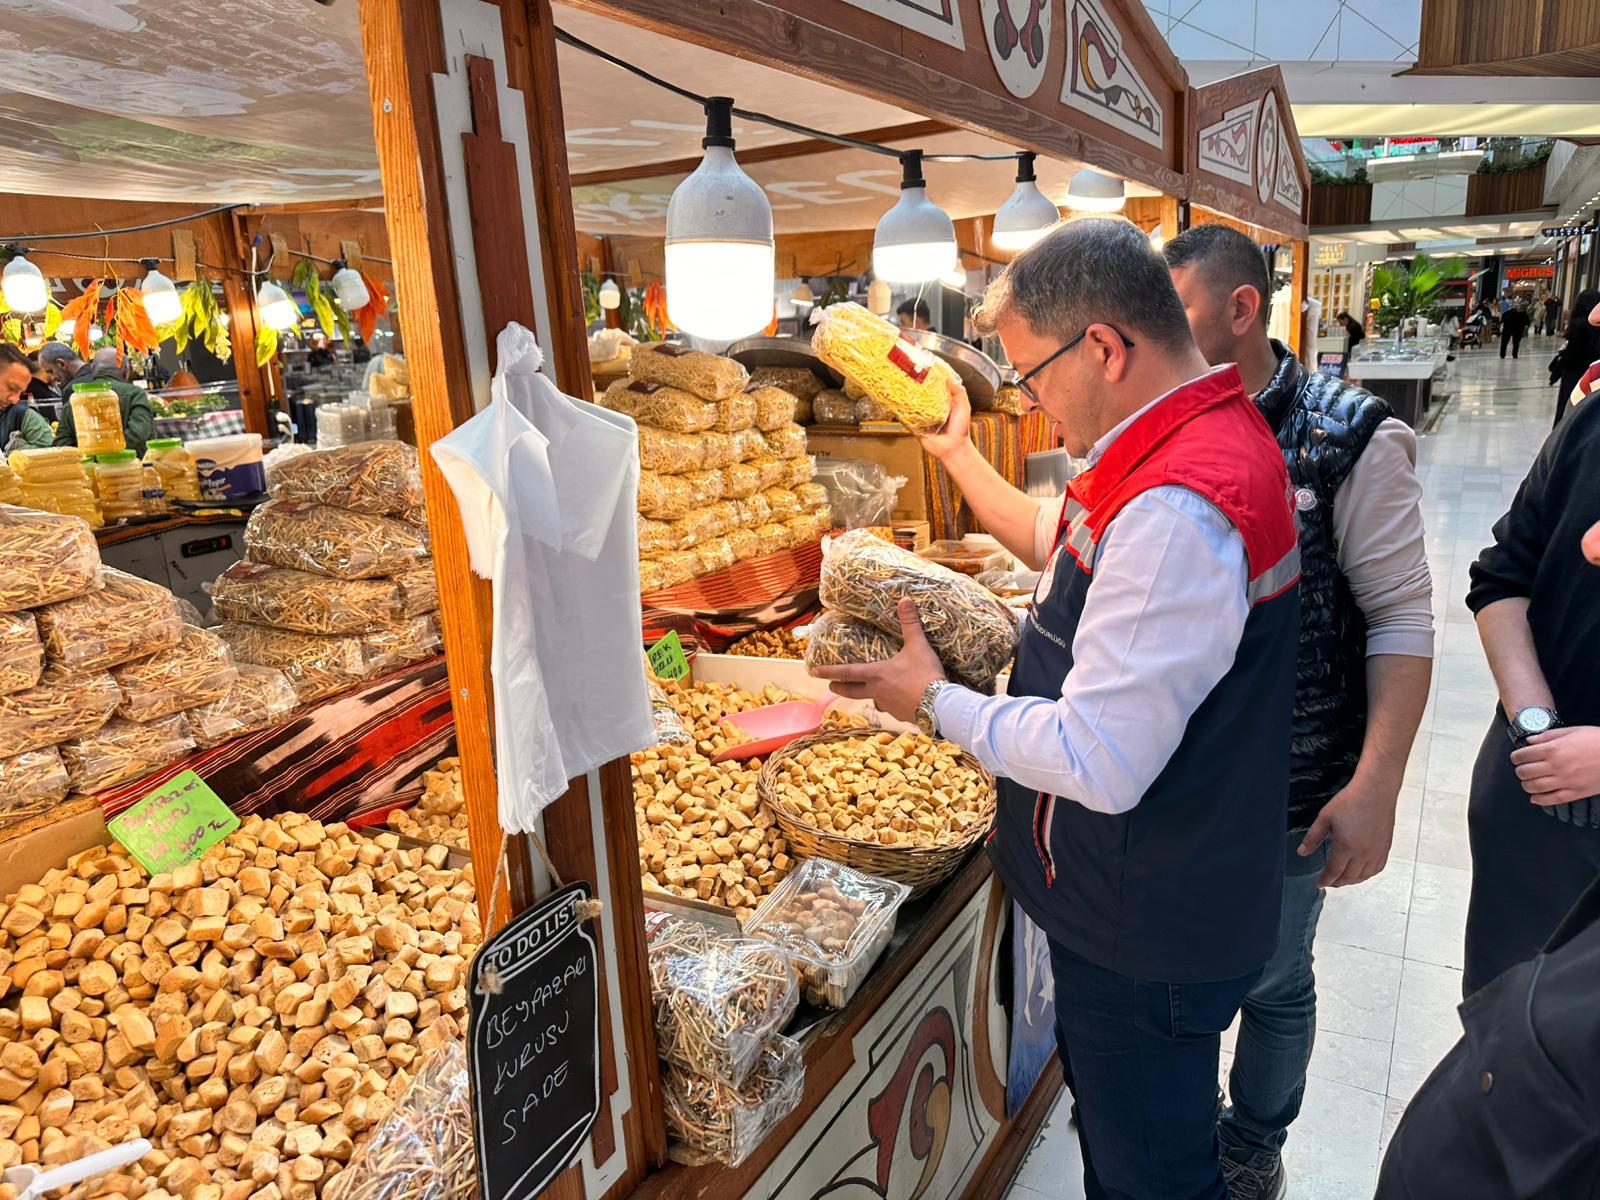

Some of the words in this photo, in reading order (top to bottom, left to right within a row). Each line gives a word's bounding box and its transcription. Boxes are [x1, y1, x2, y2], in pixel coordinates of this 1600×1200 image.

[488, 946, 512, 967] TO
[517, 928, 541, 957] DO
[545, 898, 578, 937] LIST
[501, 1060, 569, 1145] SADE
